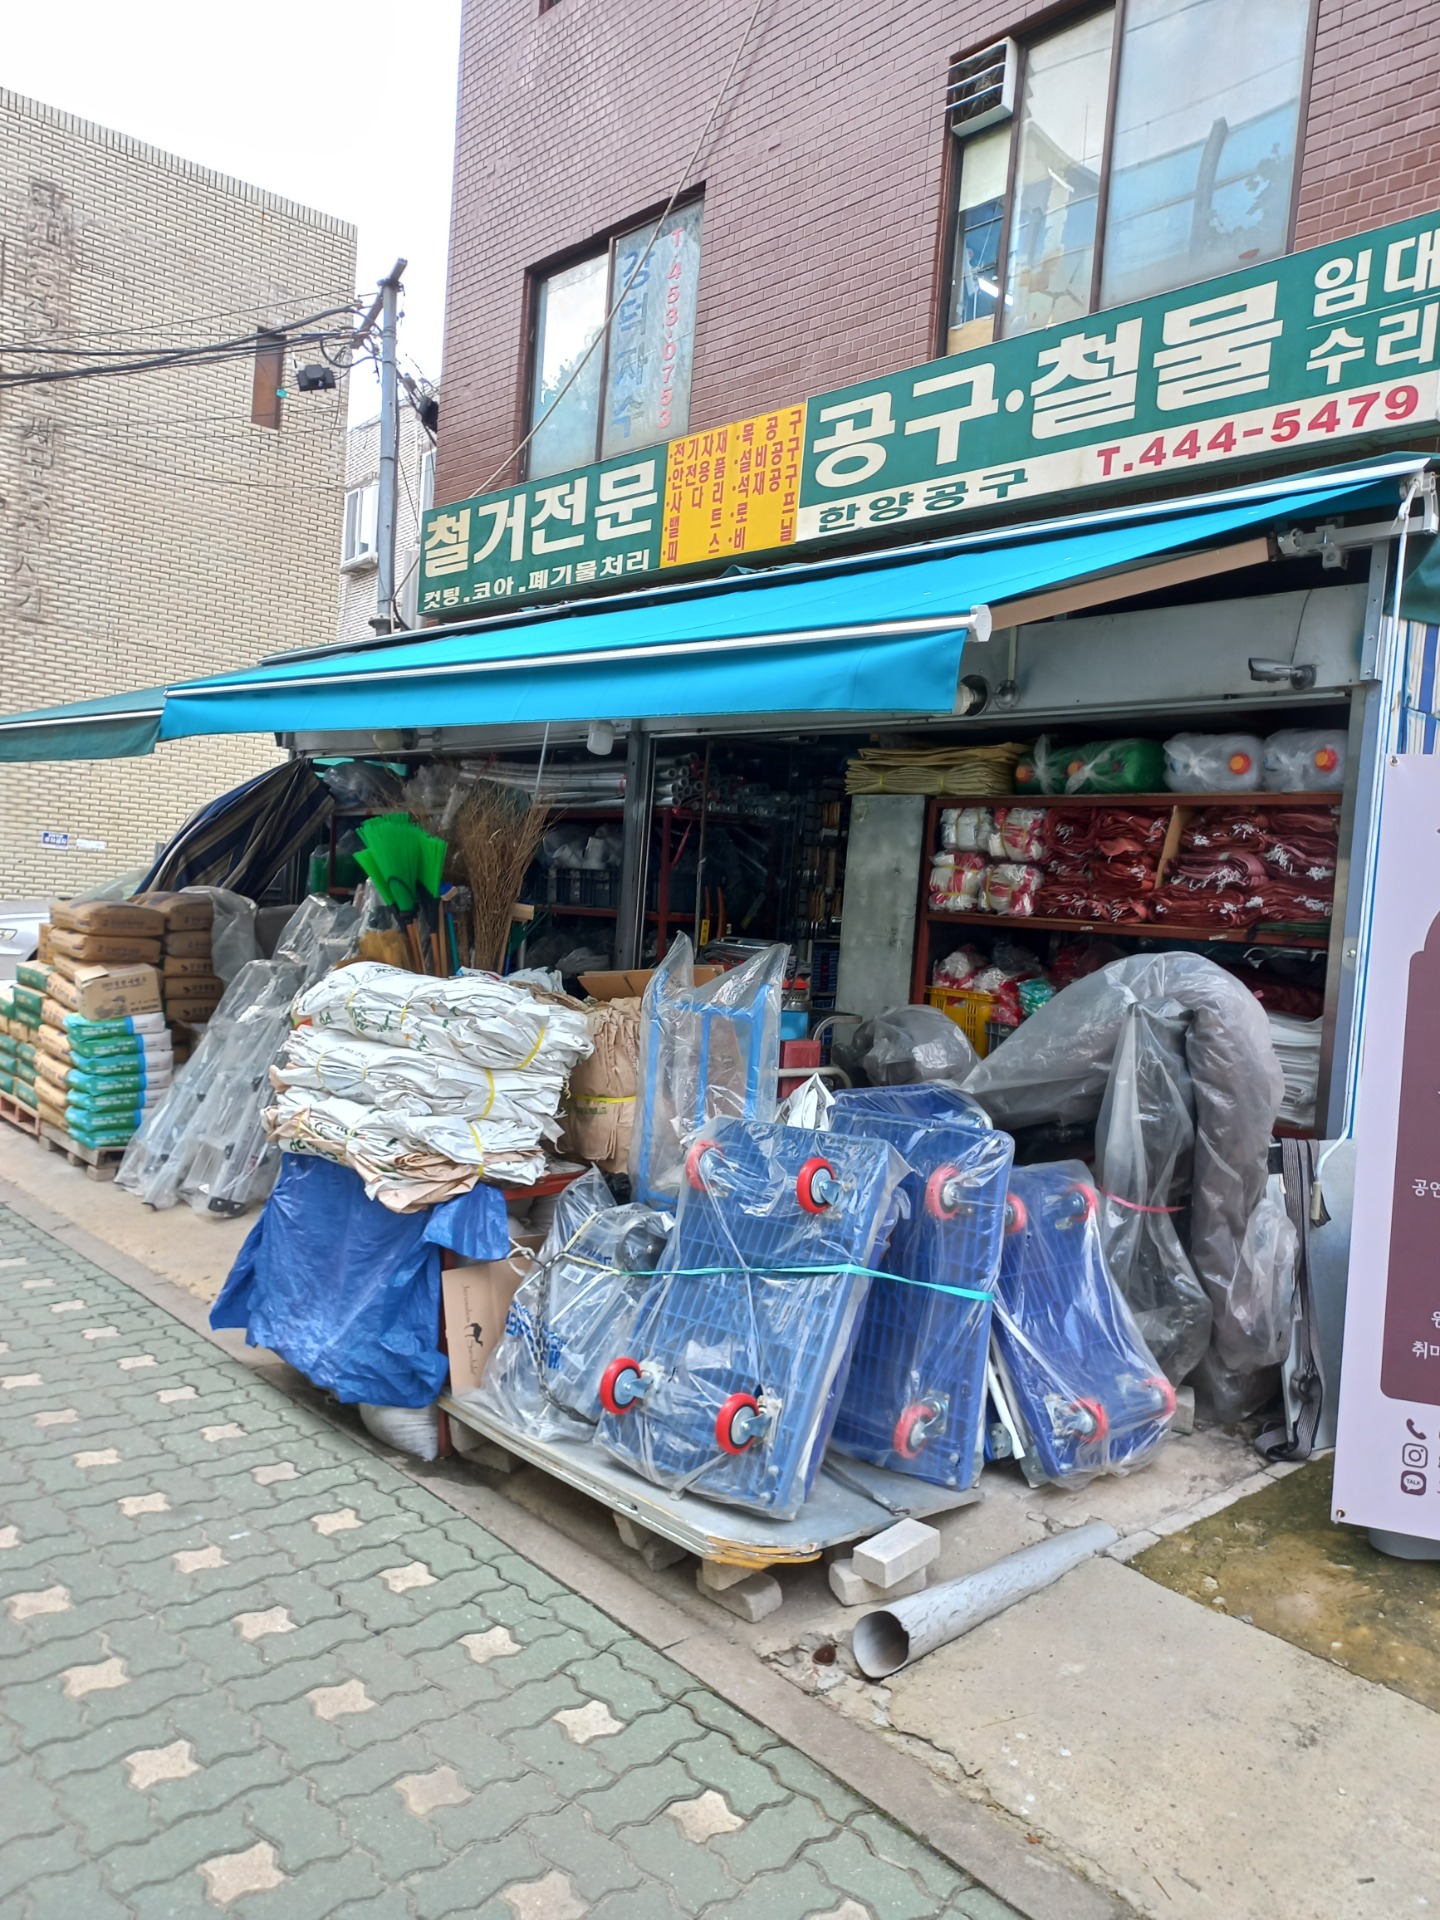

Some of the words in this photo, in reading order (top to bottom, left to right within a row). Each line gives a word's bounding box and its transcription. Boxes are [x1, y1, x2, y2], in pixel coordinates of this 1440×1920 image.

[1312, 229, 1440, 318] 임대
[1306, 304, 1440, 386] 수리
[672, 456, 726, 490] 안전용품
[673, 429, 728, 466] 전기자재
[739, 437, 800, 473] 설비공구
[737, 464, 797, 498] 석재공구
[818, 468, 1028, 534] 한양공구
[424, 459, 658, 578] 철거전문
